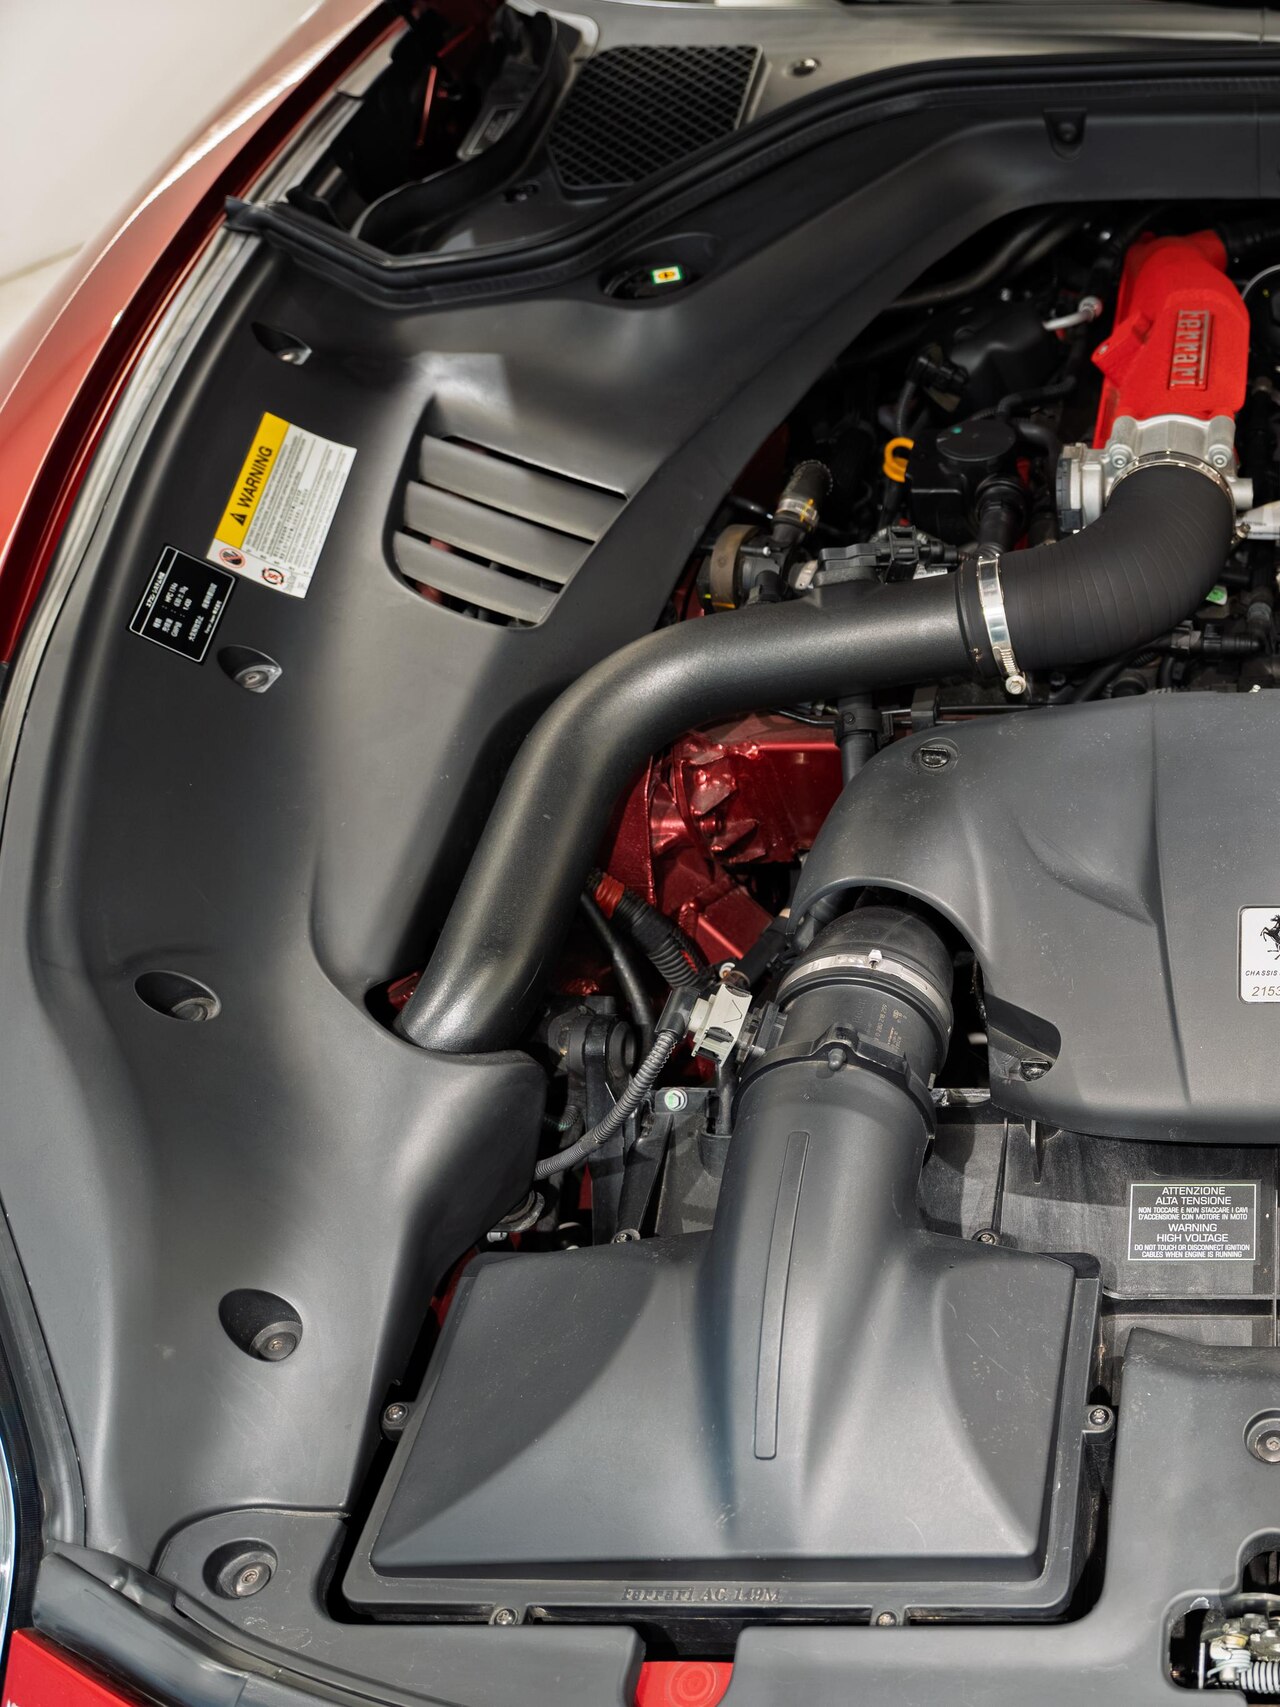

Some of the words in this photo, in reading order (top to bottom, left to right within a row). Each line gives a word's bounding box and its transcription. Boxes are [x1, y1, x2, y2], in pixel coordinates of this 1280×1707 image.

[1170, 310, 1209, 386] Ferrari
[237, 445, 272, 508] WARNING
[1162, 1186, 1226, 1195] ATTENZIONE
[1155, 1196, 1178, 1205] ALTA
[1181, 1196, 1232, 1205] TENSIONE
[1168, 1223, 1217, 1232] WARNING
[1156, 1233, 1182, 1242] HIGH
[1184, 1233, 1229, 1242] VOLTAGE
